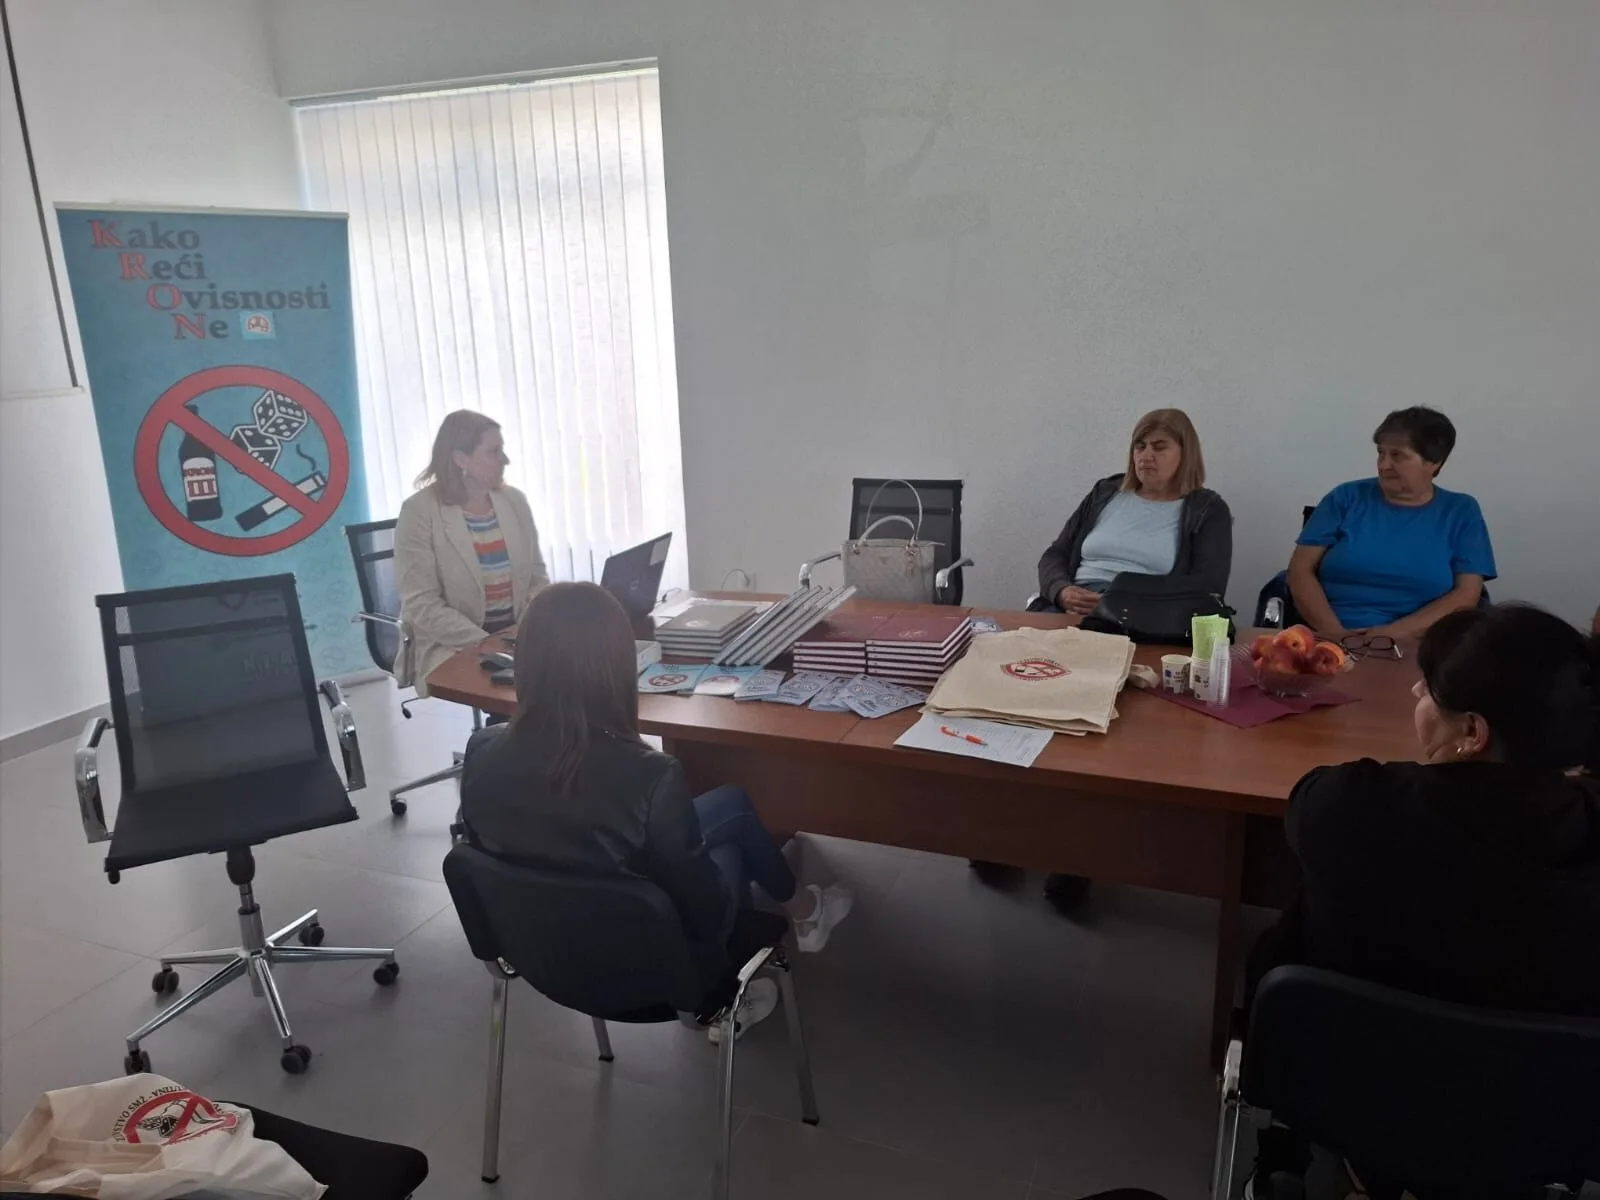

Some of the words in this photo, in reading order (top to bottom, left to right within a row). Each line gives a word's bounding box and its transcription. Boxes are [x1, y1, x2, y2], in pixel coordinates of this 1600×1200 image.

[89, 219, 200, 250] Kako
[119, 252, 208, 280] Reći
[147, 283, 331, 310] Ovisnosti
[173, 312, 229, 340] Ne
